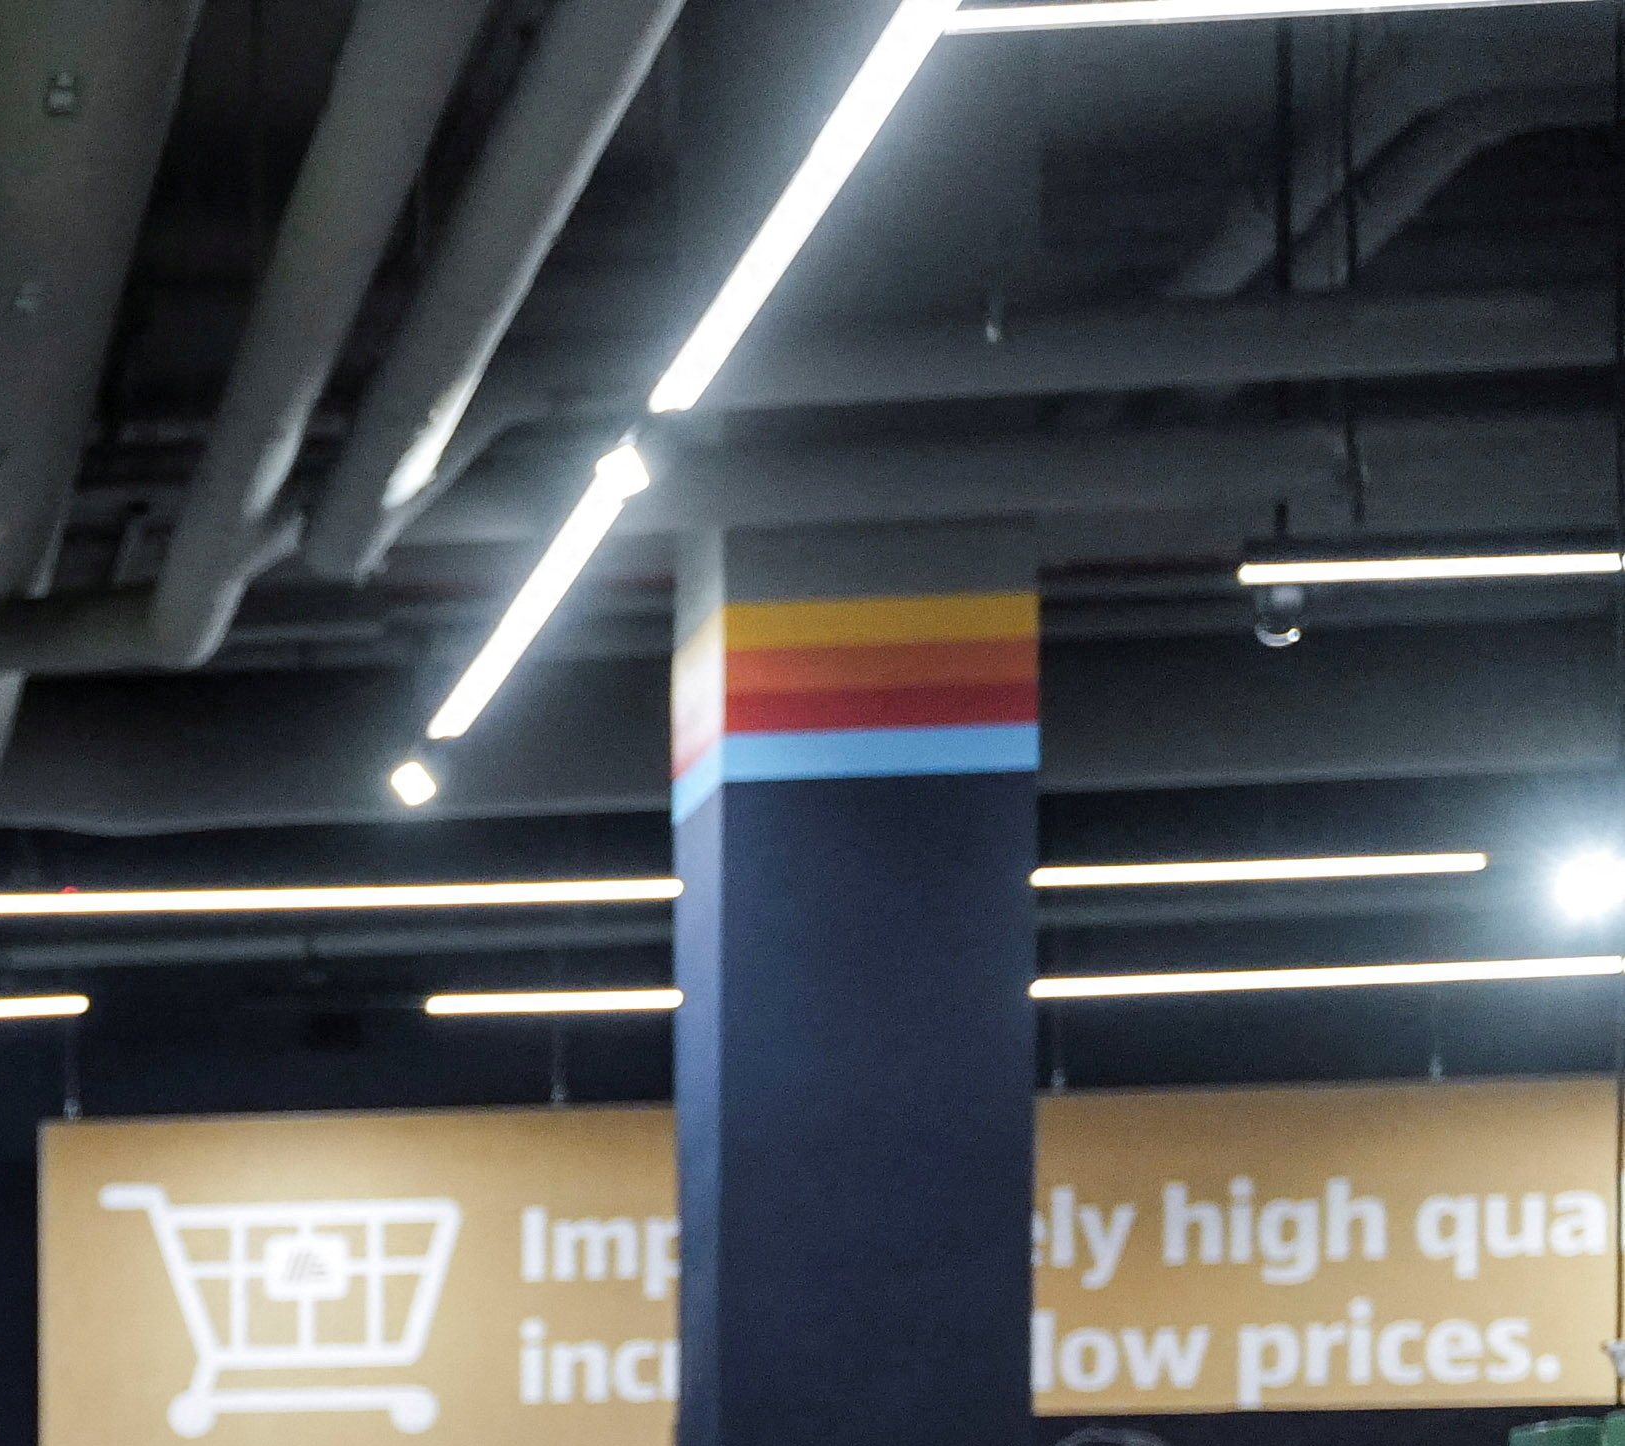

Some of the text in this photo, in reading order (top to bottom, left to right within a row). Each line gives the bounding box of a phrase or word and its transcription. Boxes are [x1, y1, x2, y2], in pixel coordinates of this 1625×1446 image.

[1032, 1185, 1135, 1288] ly
[1163, 1177, 1388, 1284] high
[1416, 1190, 1607, 1279] qua
[1031, 1309, 1208, 1391] low
[1237, 1298, 1559, 1409] prices.
